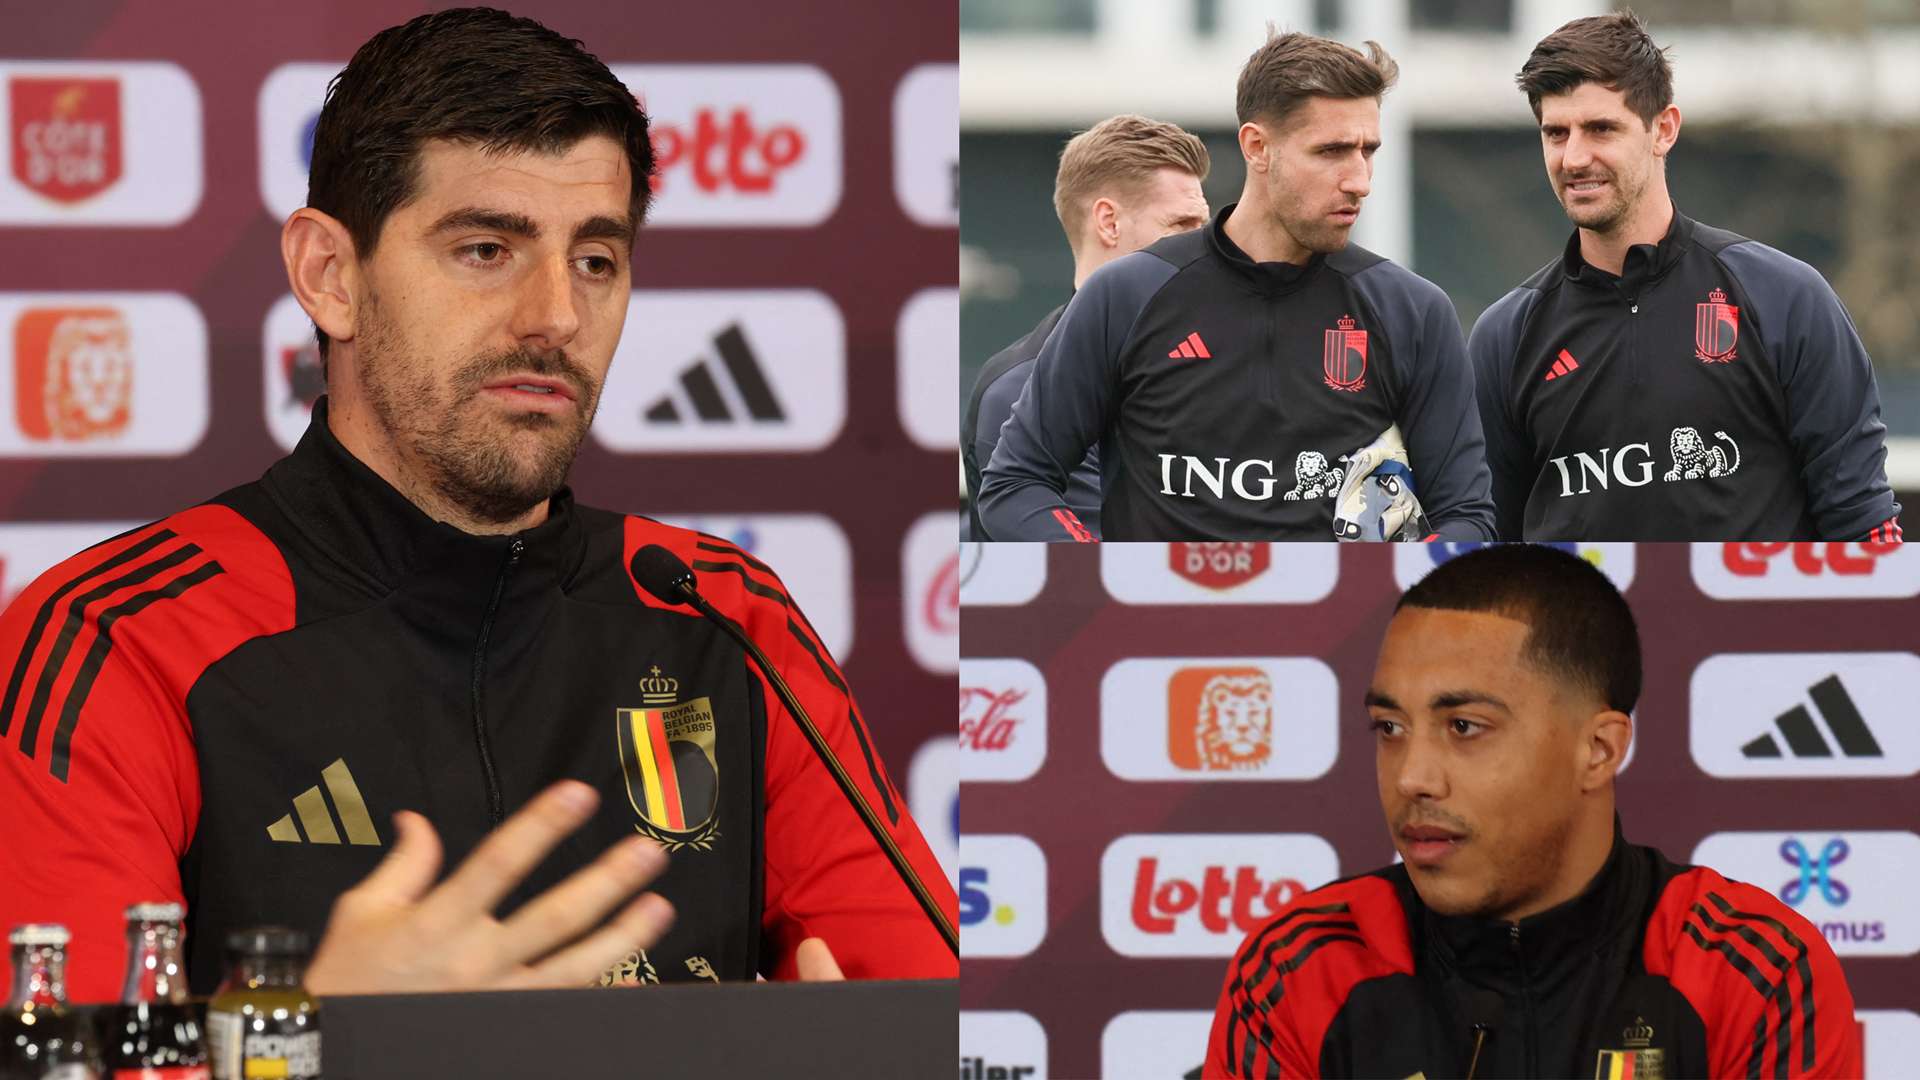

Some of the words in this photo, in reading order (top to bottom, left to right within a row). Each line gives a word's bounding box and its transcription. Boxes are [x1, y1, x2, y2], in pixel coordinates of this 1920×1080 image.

[648, 106, 806, 194] otto
[1158, 453, 1277, 501] ING
[1550, 442, 1655, 497] ING
[1186, 550, 1252, 573] D'OR
[662, 704, 697, 720] ROYAL
[664, 712, 711, 730] BELGIAN
[1820, 922, 1885, 942] mus
